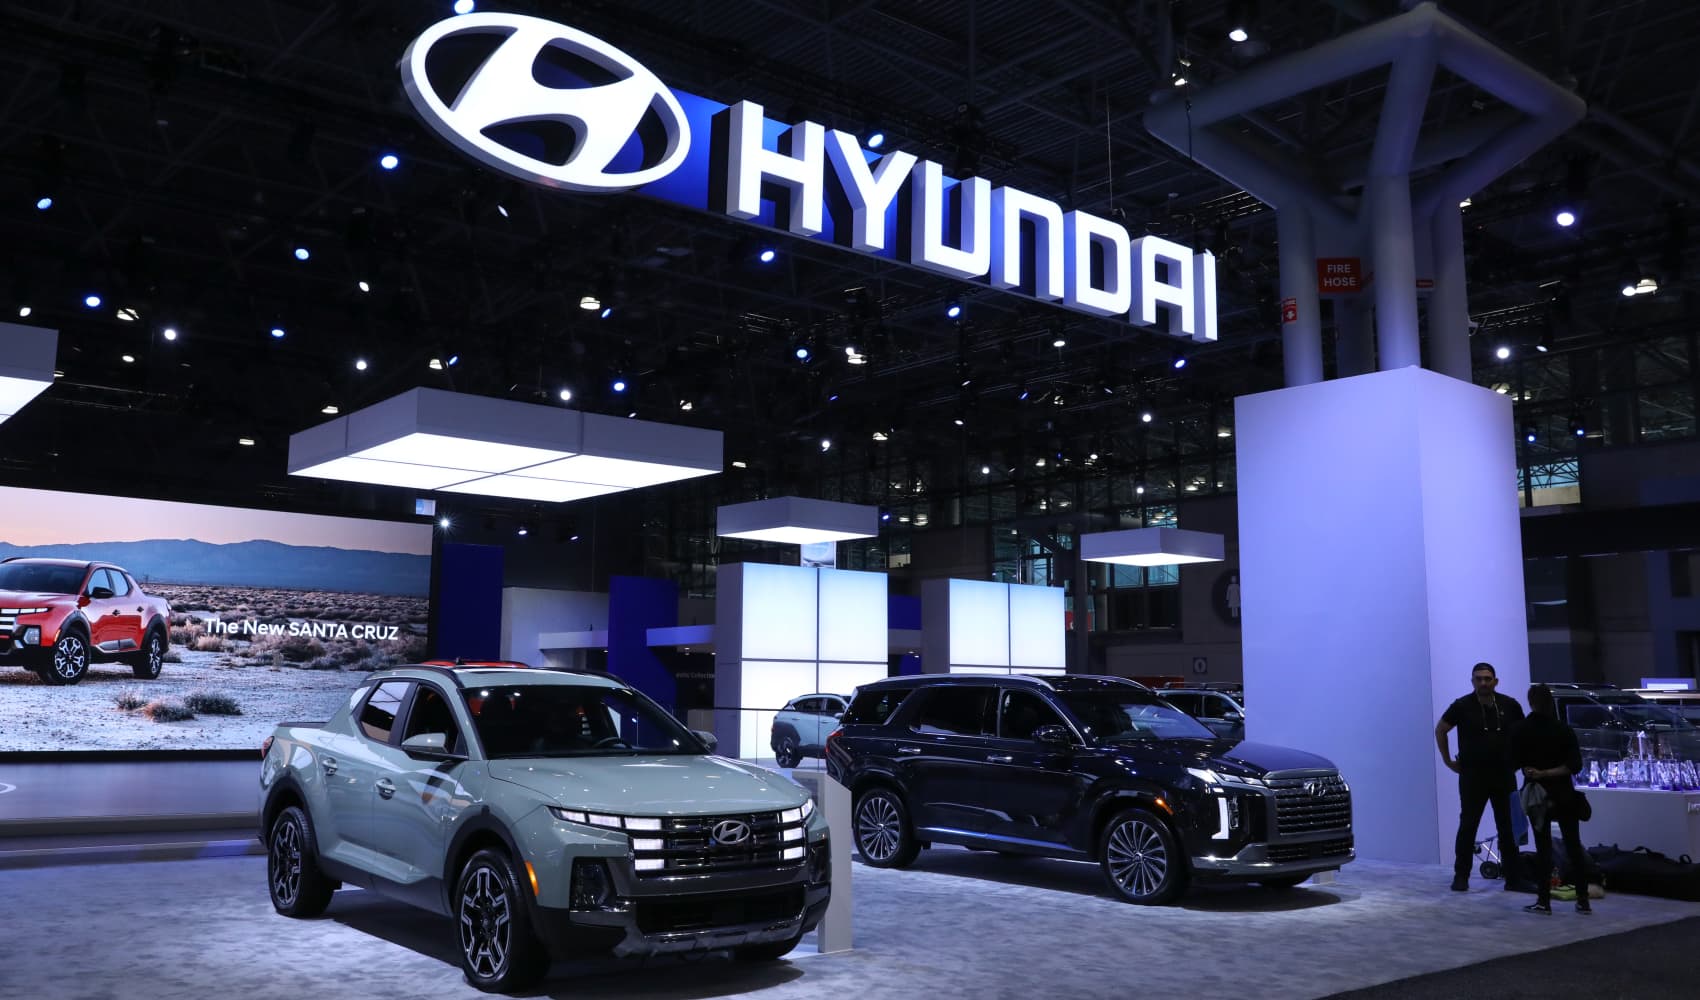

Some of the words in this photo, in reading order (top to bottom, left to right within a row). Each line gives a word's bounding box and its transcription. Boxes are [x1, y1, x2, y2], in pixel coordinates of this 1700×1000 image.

[727, 99, 1218, 342] HYUNDAI
[1327, 264, 1351, 273] FIRE
[1323, 277, 1356, 287] HOSE
[205, 618, 239, 633] The
[243, 620, 285, 635] New
[289, 622, 348, 638] SANTA
[352, 624, 399, 640] CRUZ
